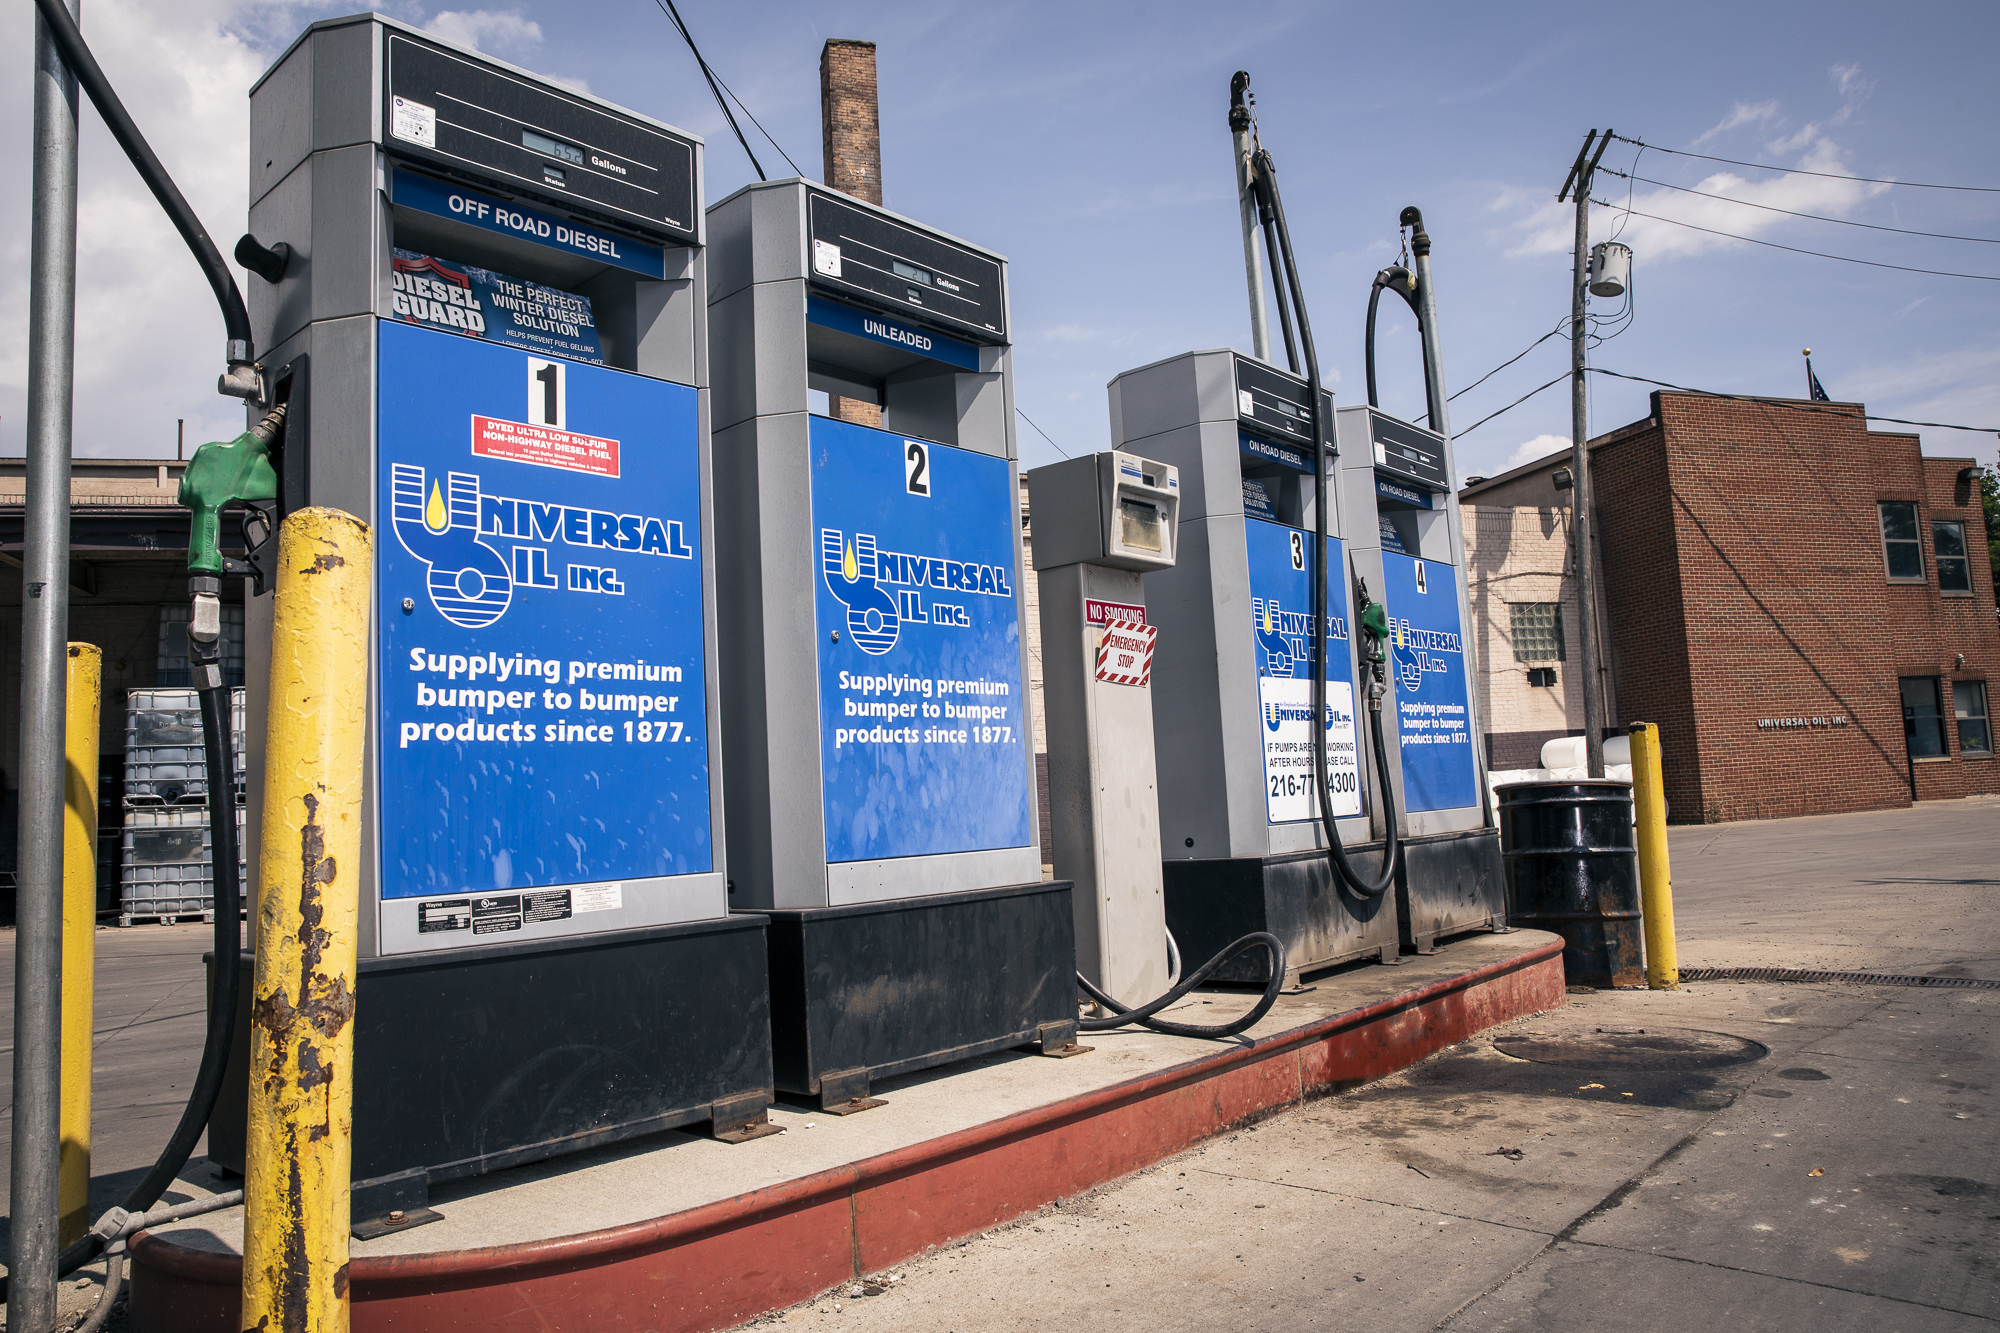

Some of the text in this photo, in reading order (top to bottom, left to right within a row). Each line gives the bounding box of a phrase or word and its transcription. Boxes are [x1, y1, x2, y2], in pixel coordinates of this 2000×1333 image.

[591, 155, 627, 176] Gallons
[544, 176, 566, 188] Status
[448, 194, 621, 259] OFF ROAD DIESEL
[664, 216, 681, 227] Wayne
[496, 279, 583, 312] THE PERFECT
[937, 277, 960, 292] Gallons
[393, 270, 486, 332] DIESEL GUARD
[491, 292, 595, 327] WINTER DIESEL
[513, 312, 580, 338] SOLUTION
[864, 319, 932, 351] UNLEADED
[506, 329, 595, 354] HELPS PREVENT FUEL GELLING
[536, 363, 558, 426] 1
[482, 430, 612, 460] NON-HIGHWAY DIESEL FUEL
[487, 421, 608, 450] DYED ULTRA LOW SULFUR
[487, 447, 505, 456] Federal
[514, 452, 535, 461] prohibits
[549, 457, 568, 466] highway
[1249, 439, 1302, 466] ON ROAD DIESEL
[907, 443, 927, 495] 2
[1379, 482, 1421, 503] ON ROAD DIESEL
[391, 462, 692, 562] UNIVERSAL
[821, 528, 1012, 600] UNIVERSAL
[1292, 533, 1303, 569] 3
[426, 543, 625, 629] OIL INC.
[1417, 562, 1425, 592] 4
[847, 588, 970, 655] OIL INC.
[1089, 603, 1143, 624] NO SMOKING
[1252, 597, 1348, 640] UNIVESAL
[1110, 634, 1147, 654] EMERGENCY
[1388, 617, 1461, 660] UNIVERSAL
[409, 647, 682, 684] Supplying premium
[1117, 654, 1135, 669] STOP
[1432, 658, 1447, 673] INC.
[839, 670, 1009, 697] Supplying premium
[416, 682, 679, 718] bumper to bumper
[844, 697, 1007, 724] bumper to bumper
[1400, 701, 1465, 717] Supplying premium
[1265, 702, 1317, 732] UNIVERSA
[1342, 714, 1352, 722] INC.
[1403, 717, 1465, 732] bumper to bumper
[1757, 717, 1810, 728] UNIVERSAL
[1832, 715, 1849, 725] INC.
[399, 718, 692, 749] products since 1877.
[835, 724, 1016, 749] products since 1877.
[1401, 732, 1469, 748] products since 1877.
[1267, 743, 1274, 753] IF
[1275, 742, 1298, 753] PUMPS
[1299, 742, 1312, 752] ARE
[1327, 742, 1354, 752] WORKING
[1269, 757, 1291, 768] AFTER
[1292, 756, 1315, 767] HOURS
[1340, 756, 1354, 766] CALL
